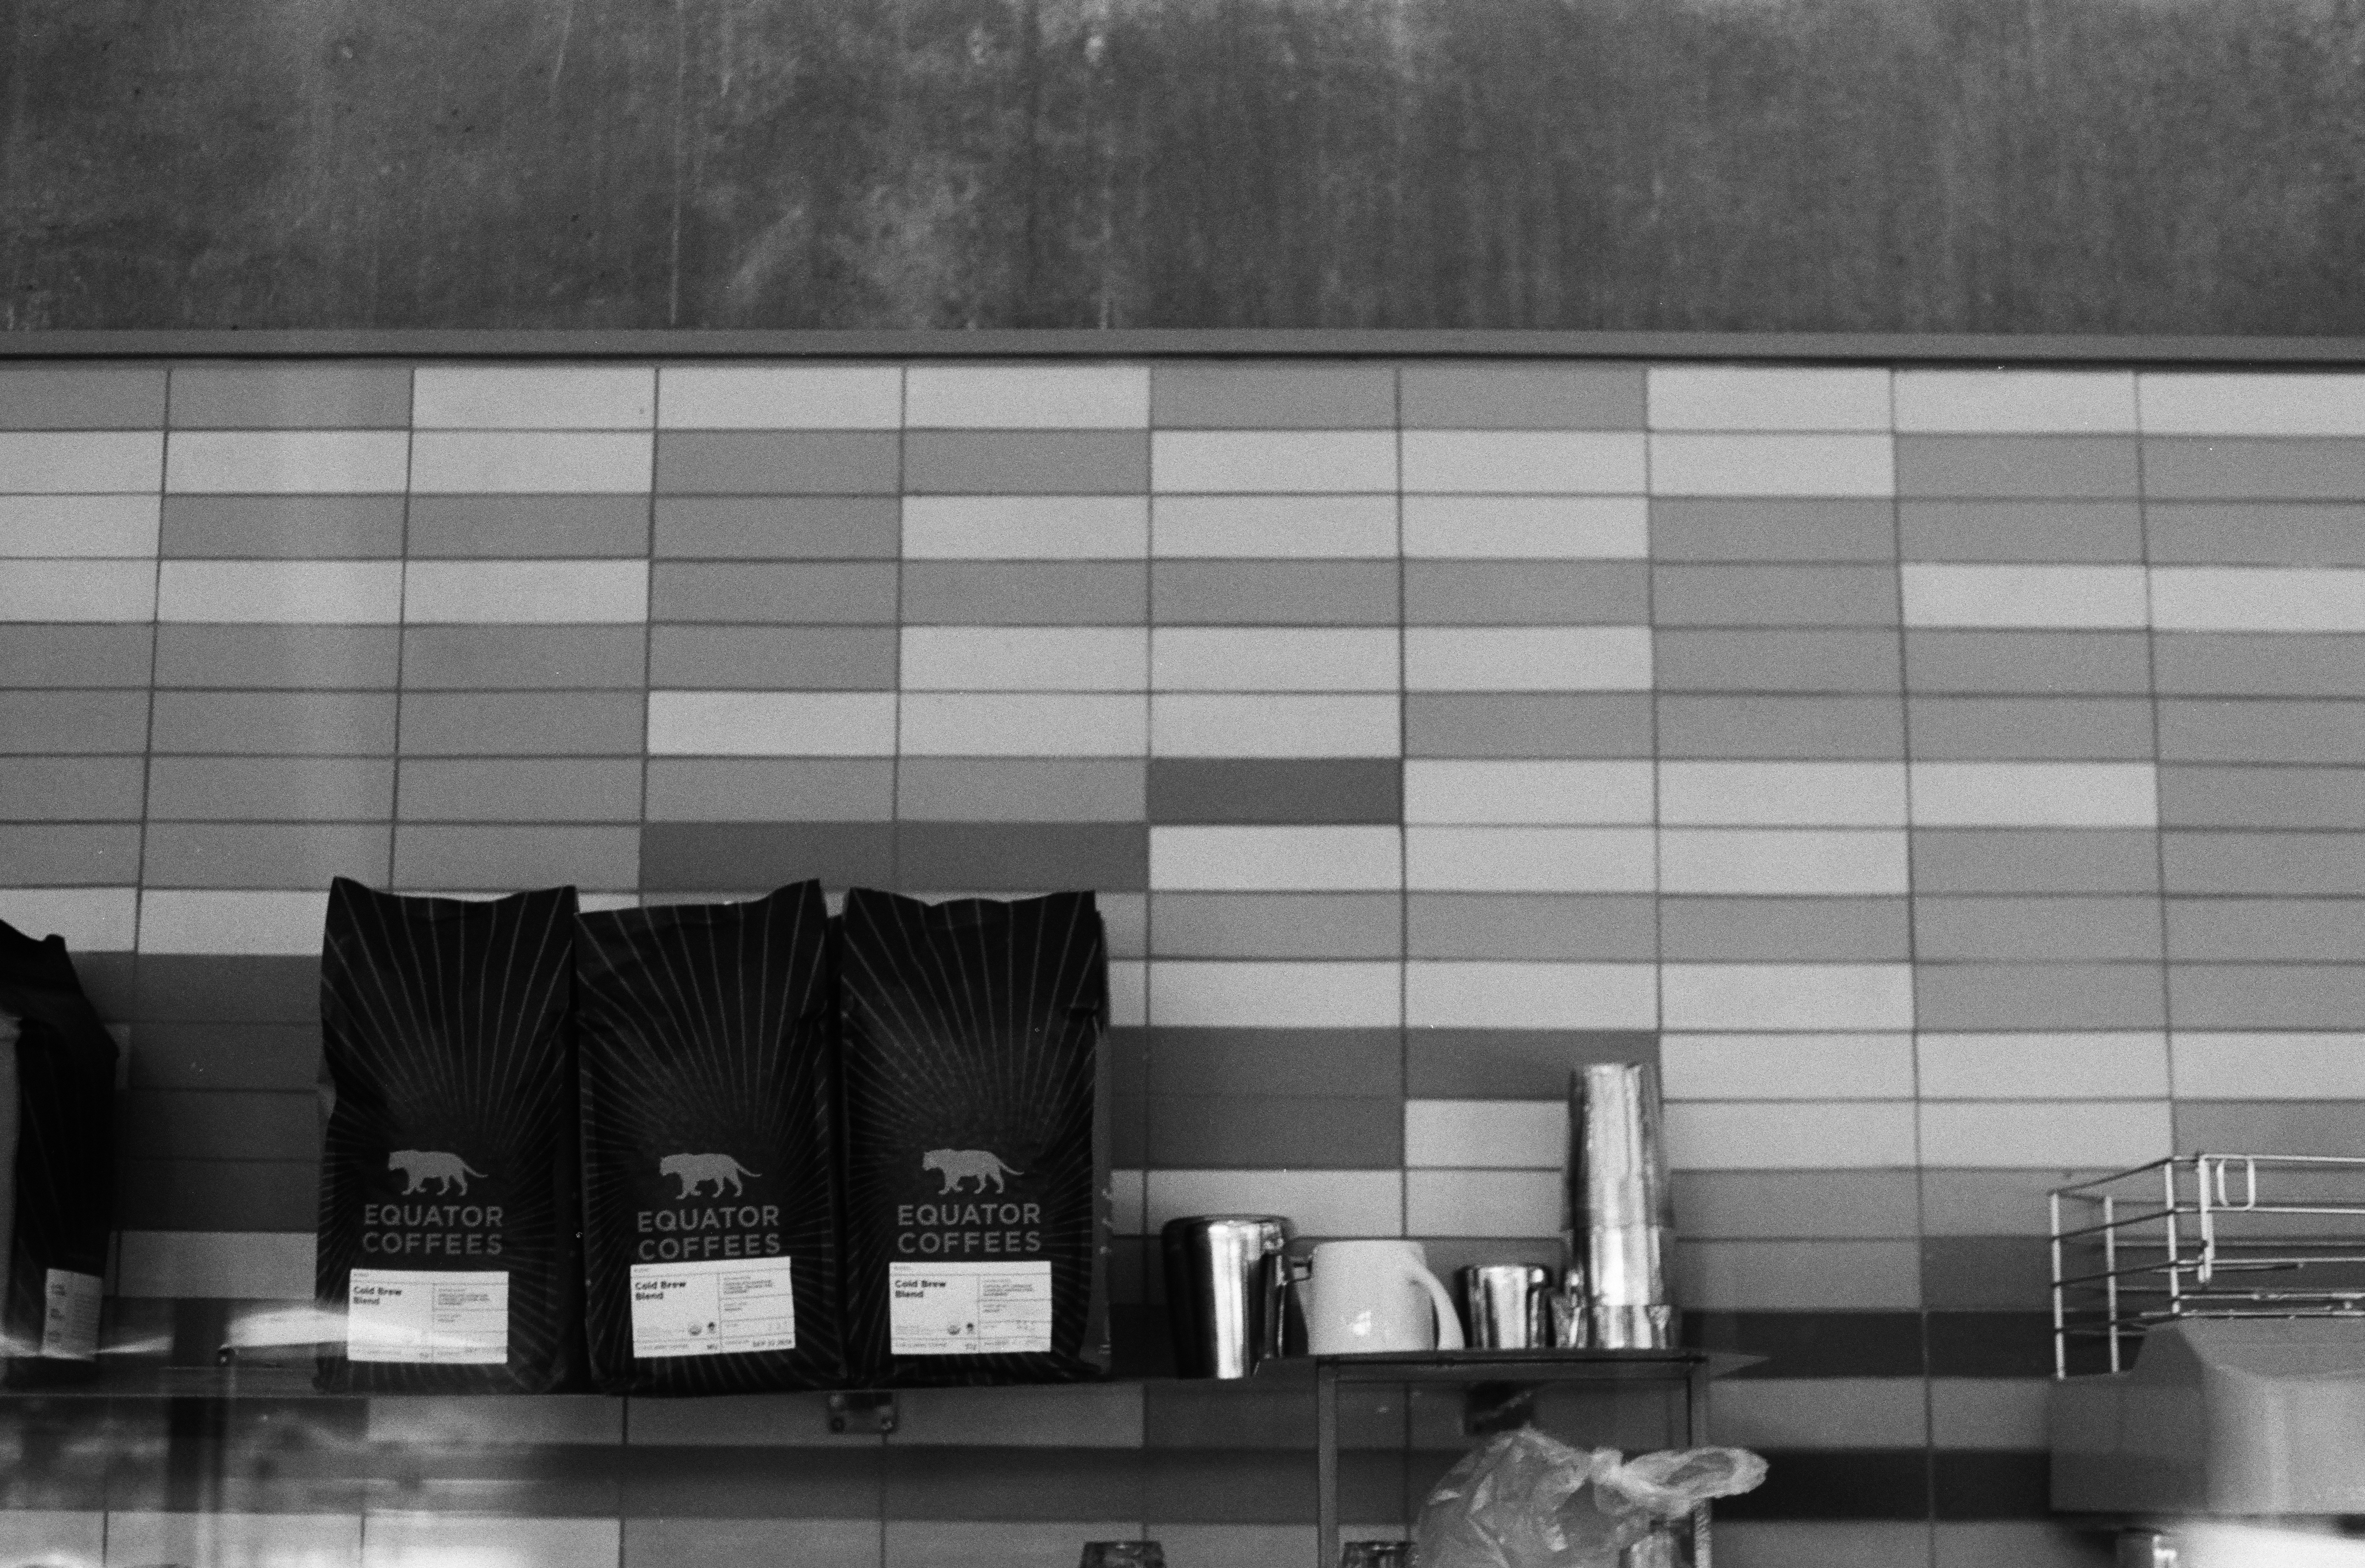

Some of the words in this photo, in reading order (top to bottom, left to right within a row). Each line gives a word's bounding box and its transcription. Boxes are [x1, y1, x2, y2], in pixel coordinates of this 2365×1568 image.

[364, 1204, 502, 1226] EQUATOR
[638, 1206, 779, 1232] EQUATOR
[898, 1204, 1040, 1225] EQUATOR
[363, 1232, 502, 1254] COFFEES
[639, 1234, 780, 1260] COFFEES
[898, 1231, 1040, 1253] COFFEES
[353, 1286, 374, 1295] Cold
[378, 1287, 402, 1295] Brew
[635, 1281, 657, 1290] Cold
[660, 1280, 686, 1289] Brew
[921, 1280, 946, 1288] Brew
[636, 1292, 663, 1300] Blend
